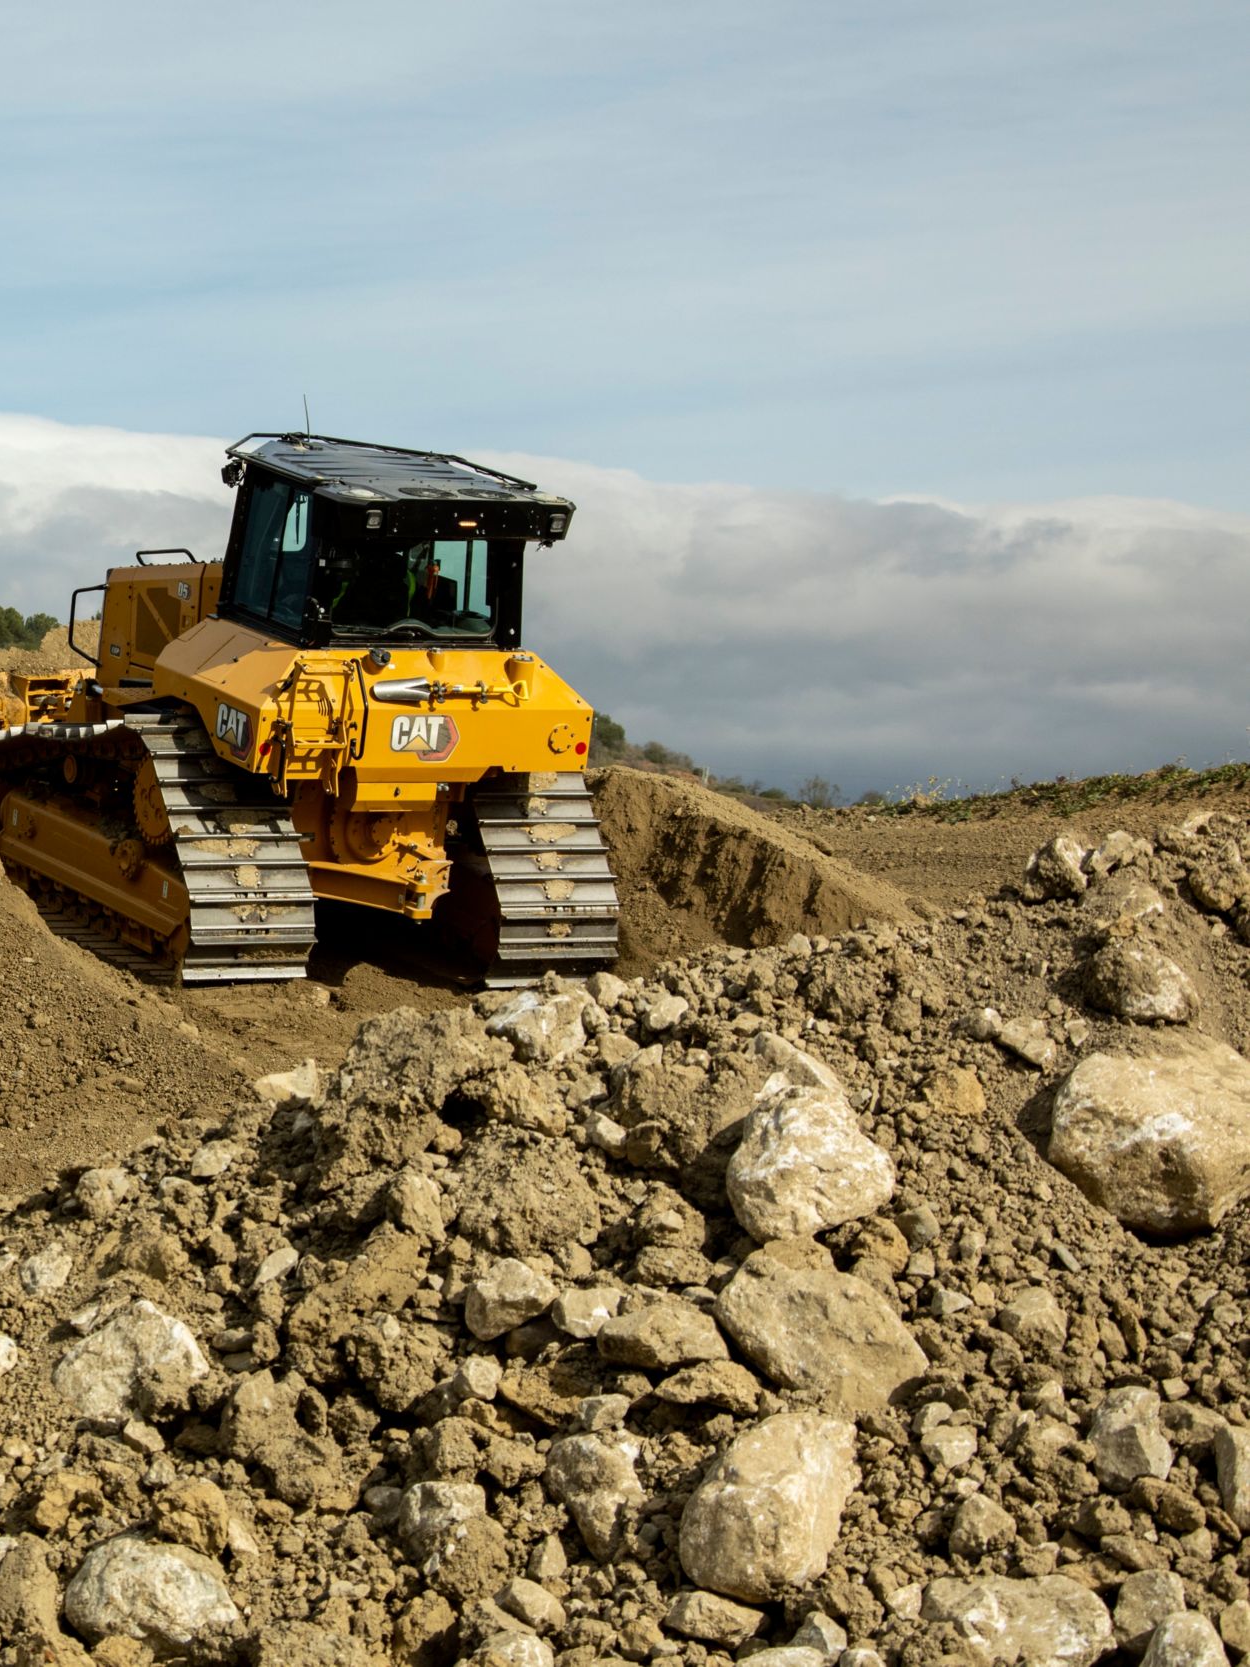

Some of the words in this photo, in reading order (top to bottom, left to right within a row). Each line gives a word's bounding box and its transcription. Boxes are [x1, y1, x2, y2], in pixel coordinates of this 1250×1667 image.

[178, 581, 189, 599] D5
[216, 703, 247, 748] CAT
[391, 716, 445, 750] CAT
